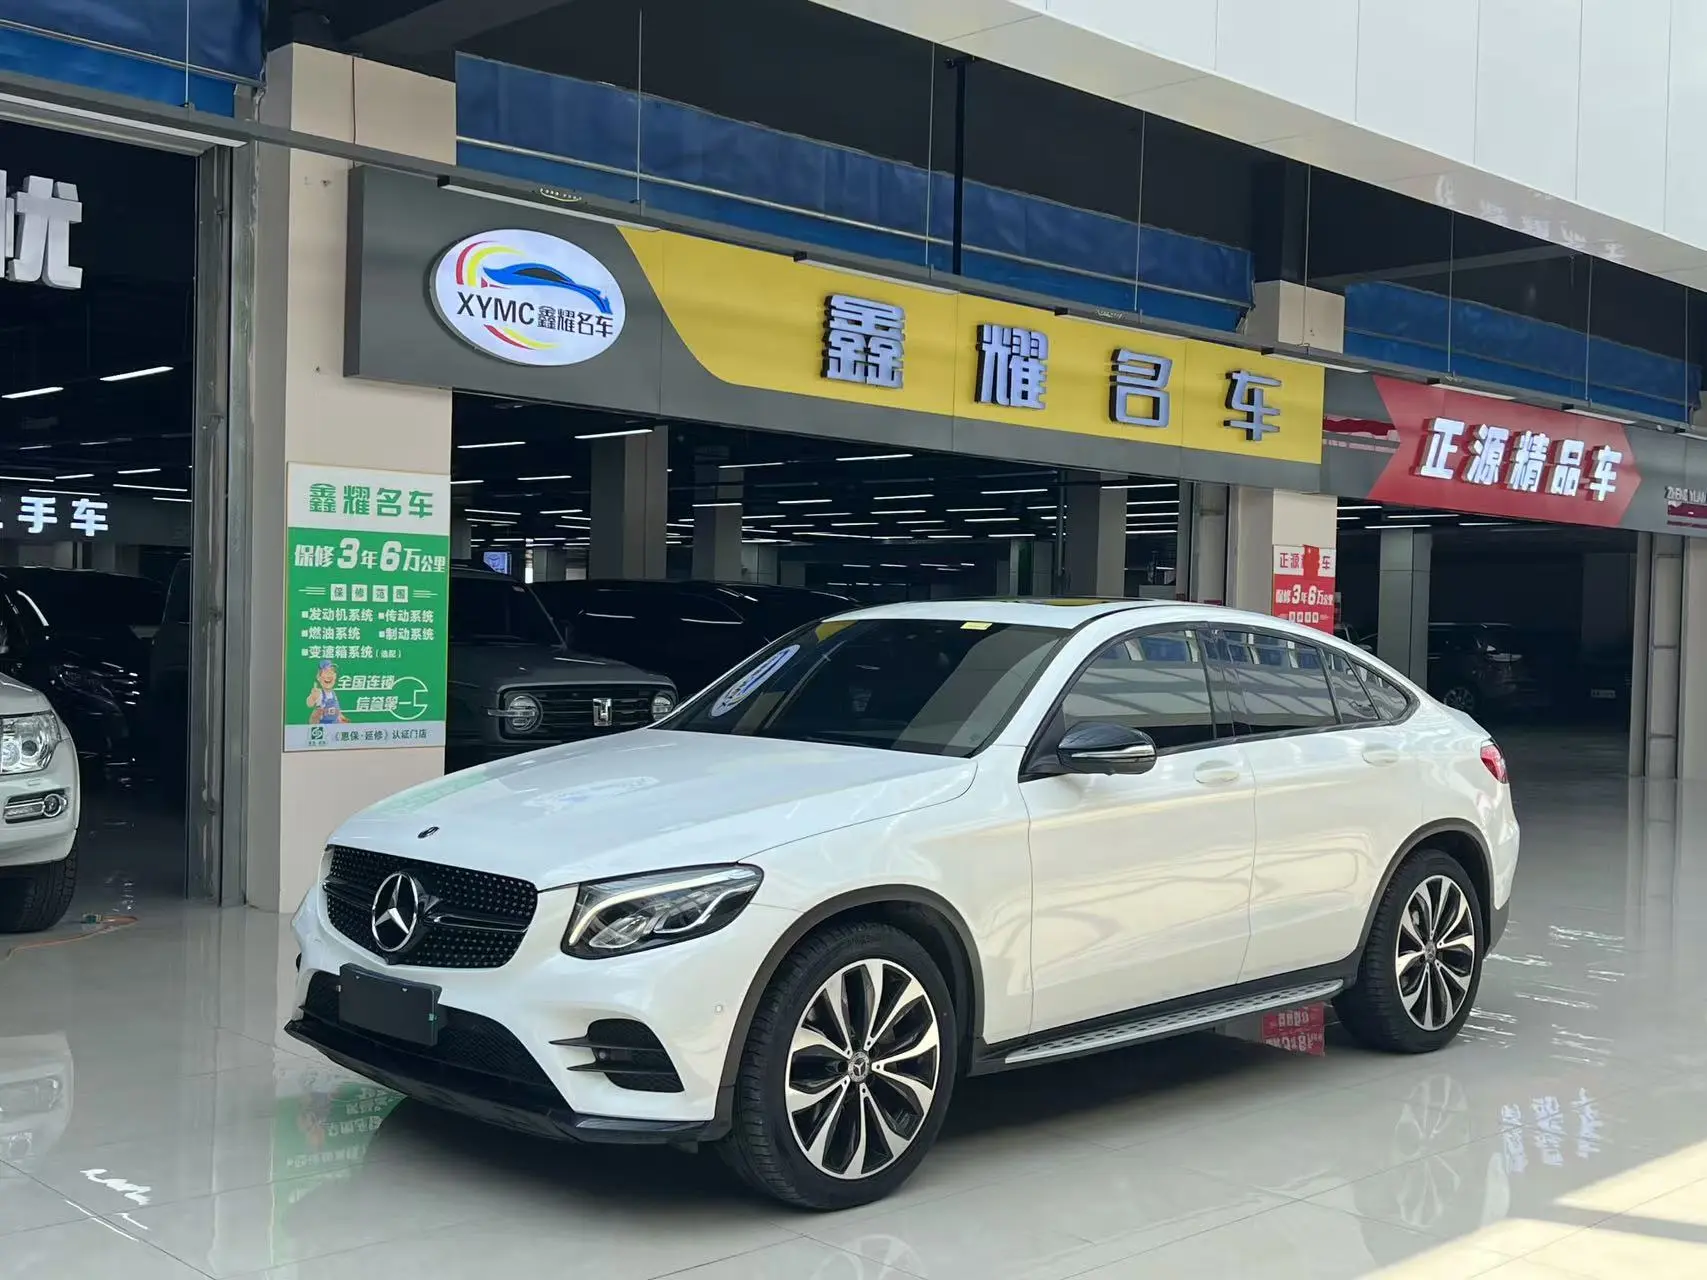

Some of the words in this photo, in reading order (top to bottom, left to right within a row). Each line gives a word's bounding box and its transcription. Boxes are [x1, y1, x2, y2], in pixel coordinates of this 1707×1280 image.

[456, 291, 535, 325] XYMC
[537, 304, 614, 338] 鑫耀名车
[821, 293, 1283, 442] 鑫耀名车
[1412, 416, 1623, 502] 正源精品车
[0, 496, 109, 537] 手车
[309, 483, 434, 519] 鑫耀名车
[294, 537, 446, 573] 保修3年6万公里
[333, 585, 407, 601] 保修范围
[308, 608, 374, 622] 发动机系统
[385, 609, 434, 623] 传动系统
[308, 627, 361, 641] 燃油系统
[385, 627, 434, 641] 制动系统
[308, 645, 373, 659] 变速箱系统
[338, 675, 396, 690] 全国连锁
